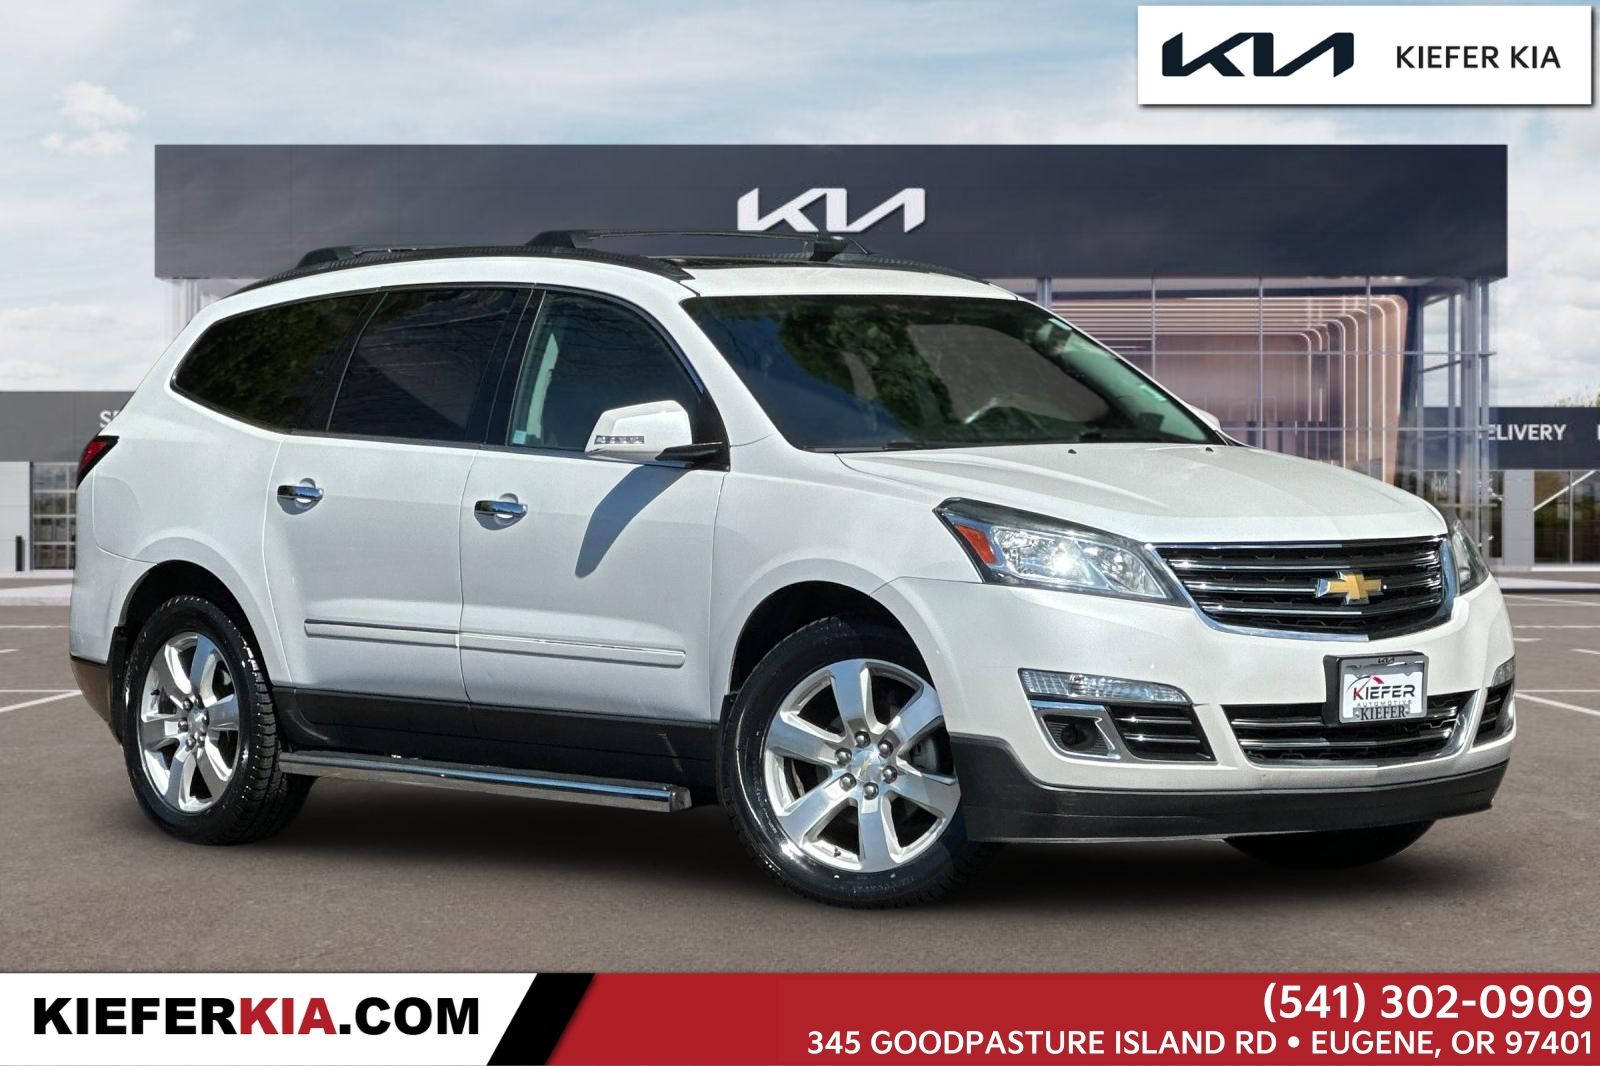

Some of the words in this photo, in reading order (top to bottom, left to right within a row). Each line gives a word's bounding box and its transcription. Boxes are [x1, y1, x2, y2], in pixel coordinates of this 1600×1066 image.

[737, 187, 926, 233] KIA
[1478, 423, 1567, 441] ELIVERY
[1353, 684, 1416, 701] KIEFER
[1360, 704, 1407, 721] KIEFER
